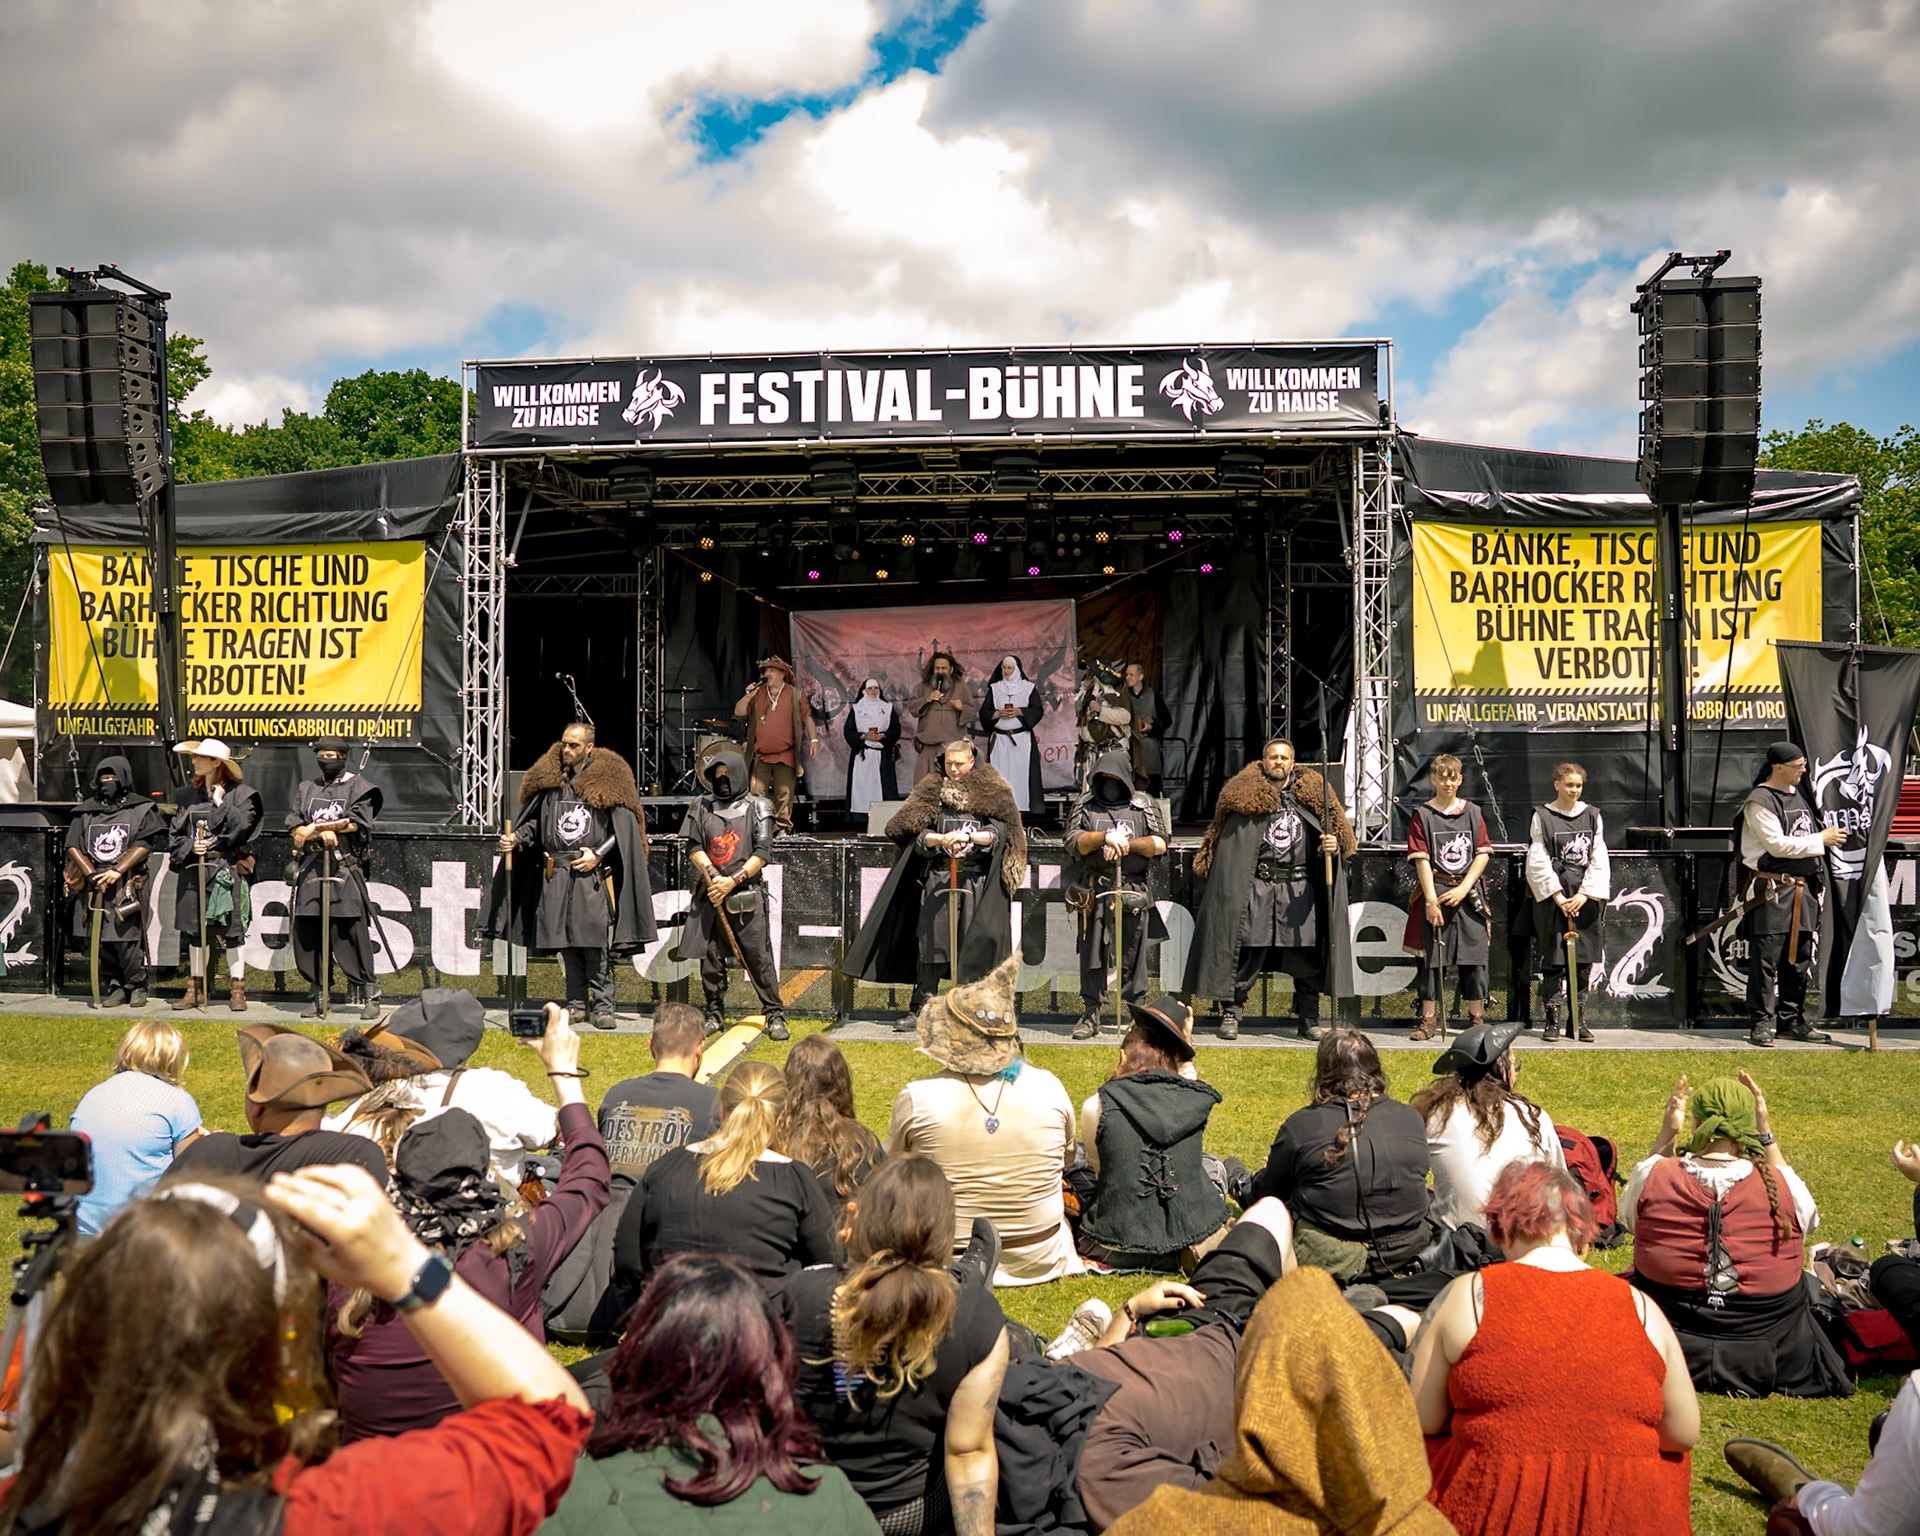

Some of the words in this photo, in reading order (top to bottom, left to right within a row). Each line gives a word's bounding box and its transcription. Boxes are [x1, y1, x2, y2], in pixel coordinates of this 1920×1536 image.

[492, 380, 621, 408] WILLKOMMEN
[699, 364, 1145, 426] FESTIVAL-BÜHNE
[1226, 366, 1362, 391] WILLKOMMEN
[511, 407, 536, 429] ZU
[539, 404, 600, 428] HAUSE
[1248, 392, 1273, 415] ZU
[1277, 389, 1340, 415] HAUSE
[1472, 528, 1581, 569] BÄNKE,
[1700, 531, 1761, 564] UND
[101, 552, 201, 590] BÄNE,
[211, 555, 303, 587] TISCHE
[312, 554, 369, 586] UND
[1450, 570, 1625, 604] BARHOCKER
[80, 591, 242, 624] BARHCKER
[251, 590, 389, 623] RICHTUNG
[1476, 604, 1575, 642] BÜHNE
[1583, 608, 1702, 641] TRAGN
[1711, 607, 1757, 640] IST
[103, 623, 195, 660] BÜHE
[203, 628, 312, 660] TRAGEN
[319, 627, 363, 659] IST
[357, 718, 412, 738] DROHT!
[605, 1117, 693, 1146] DESTROY
